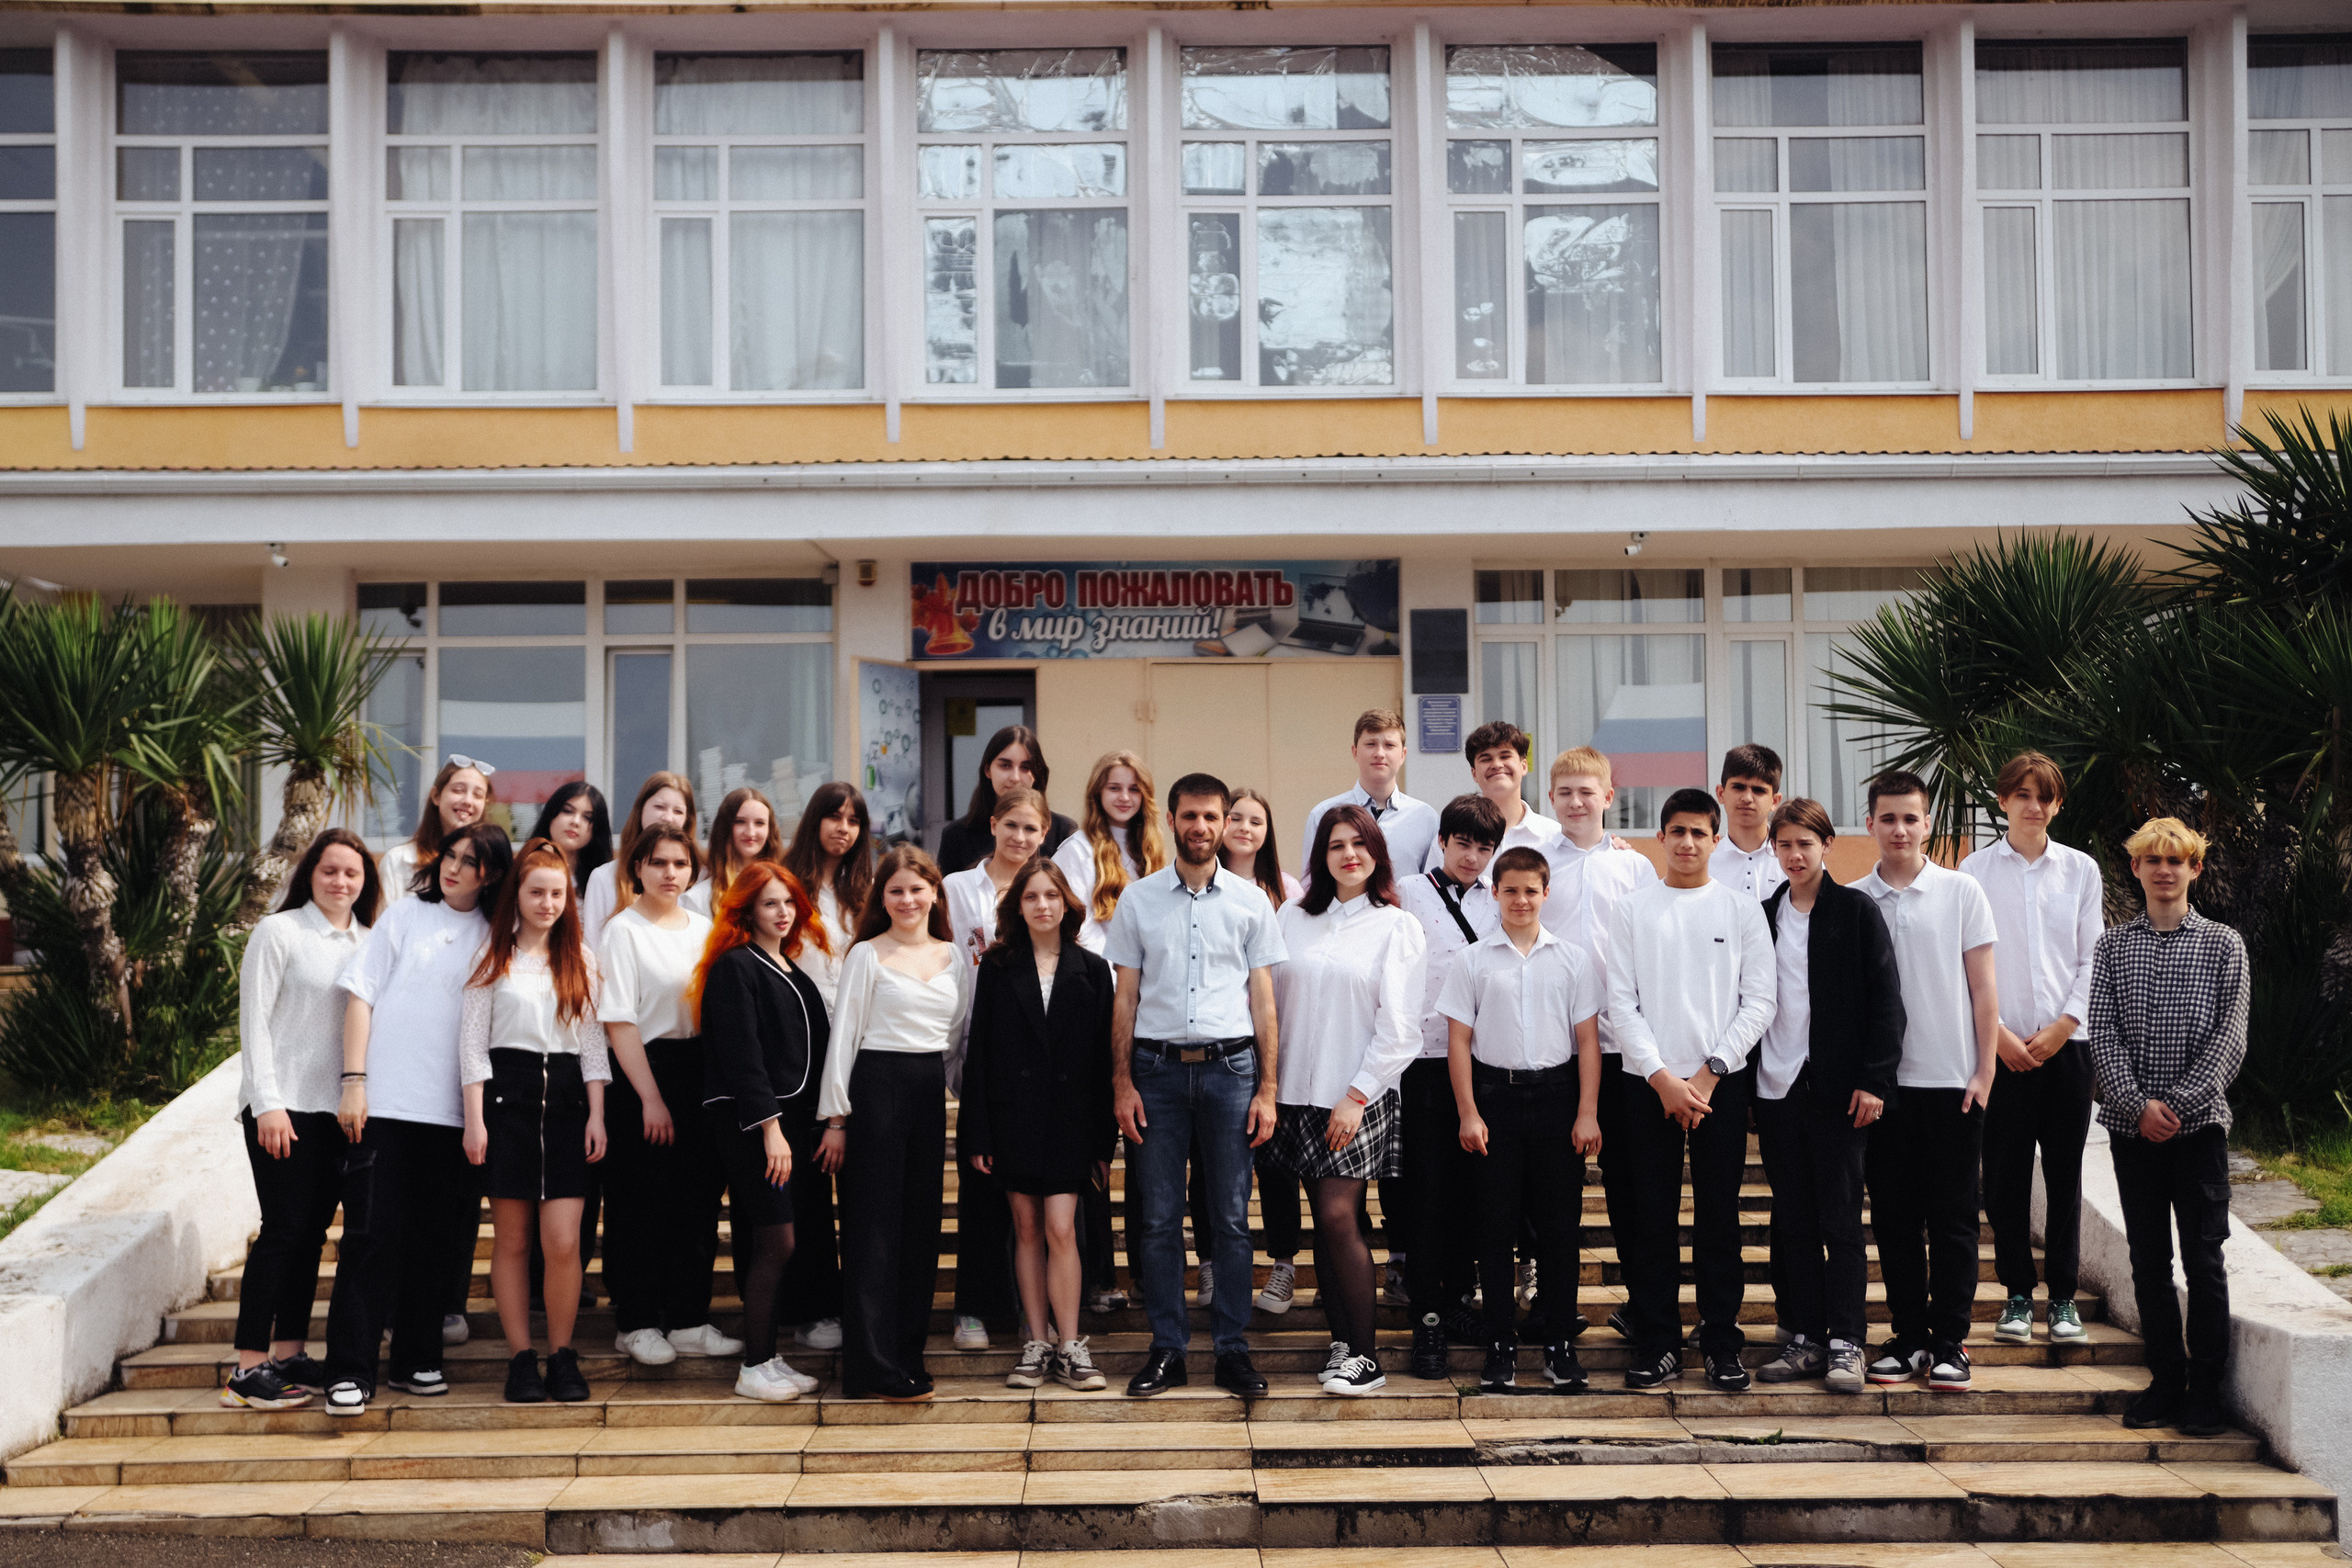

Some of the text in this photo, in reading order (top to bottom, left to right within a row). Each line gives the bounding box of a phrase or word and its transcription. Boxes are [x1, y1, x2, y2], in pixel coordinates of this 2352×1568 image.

[956, 569, 1295, 614] ДОБРО ПОЖАЛОВАТЬ
[988, 608, 1223, 649] в мир знаний!
